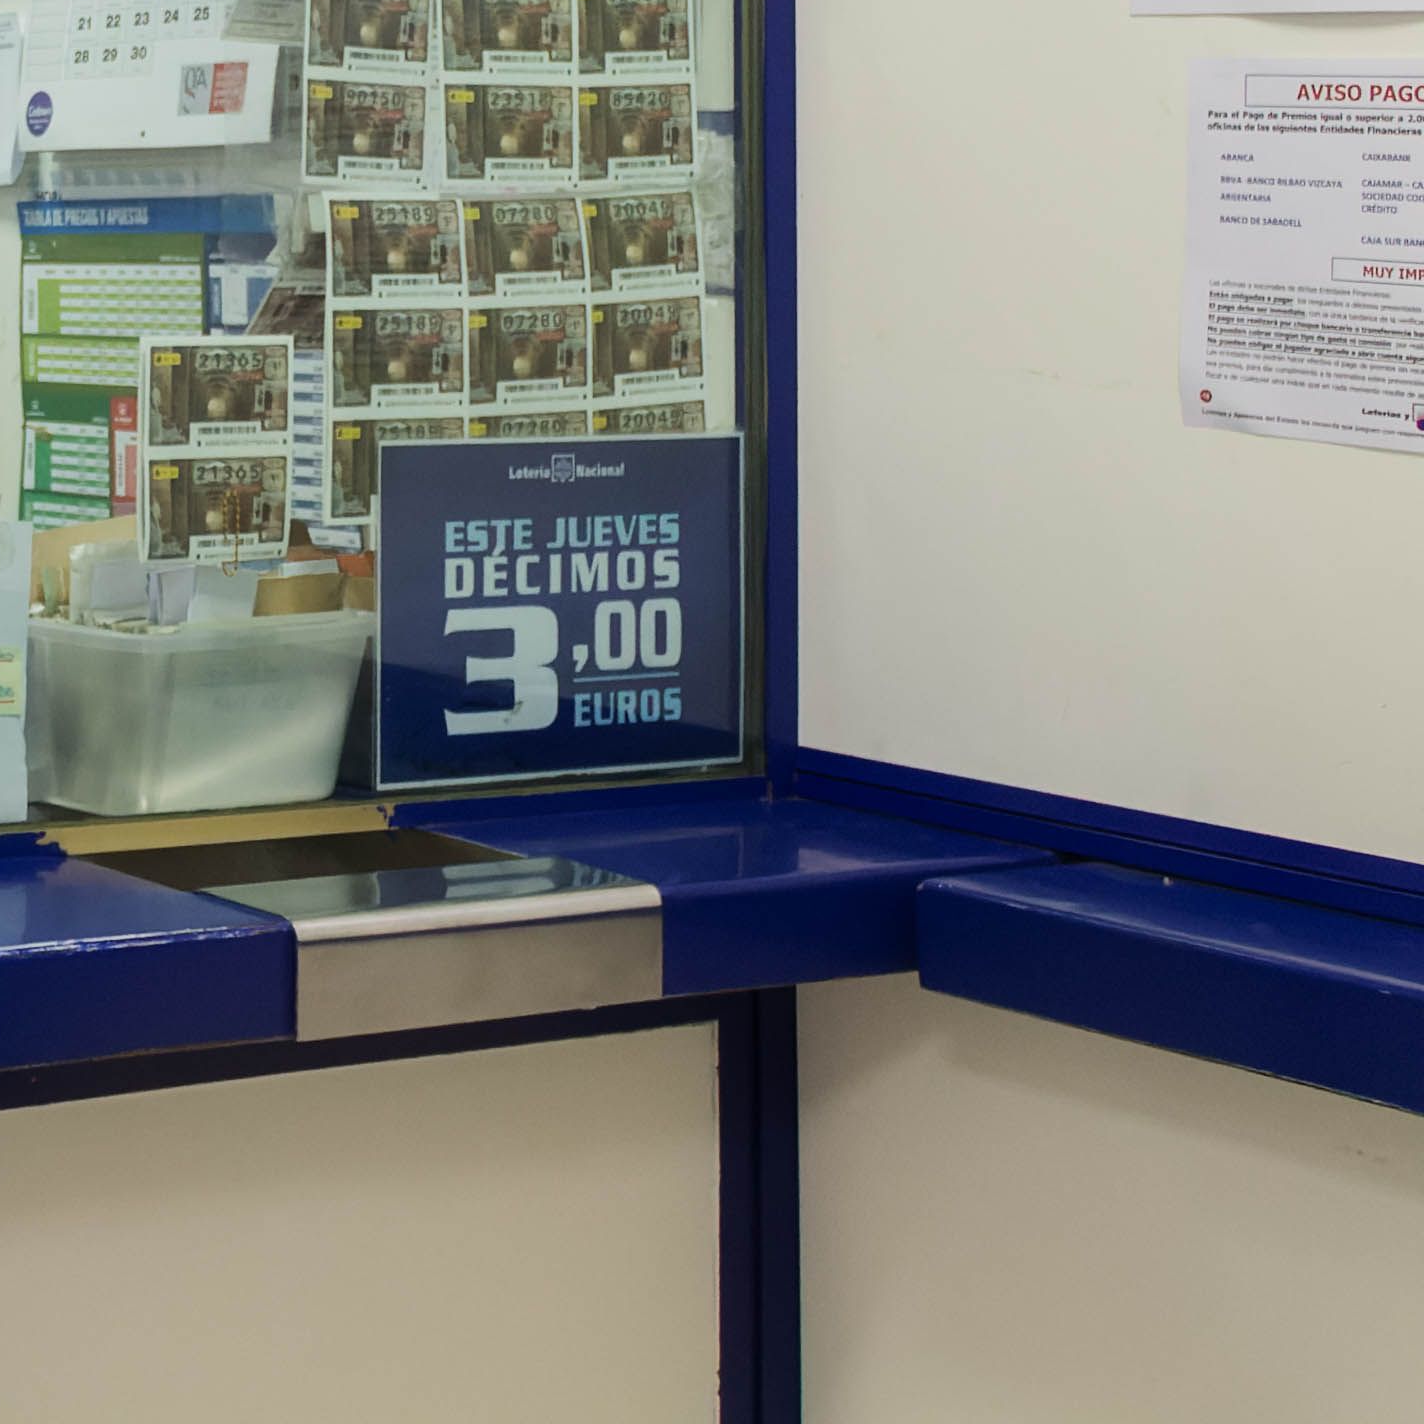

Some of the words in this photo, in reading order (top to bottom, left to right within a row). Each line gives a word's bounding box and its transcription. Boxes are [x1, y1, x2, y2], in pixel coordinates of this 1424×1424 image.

[1297, 84, 1362, 102] AVISO
[1363, 265, 1394, 279] MUY
[445, 518, 533, 553] ESTE
[547, 513, 680, 549] JUEVES
[444, 546, 681, 599] DÉCIMOS
[443, 597, 683, 737] 3,00
[573, 687, 682, 728] EUROS
